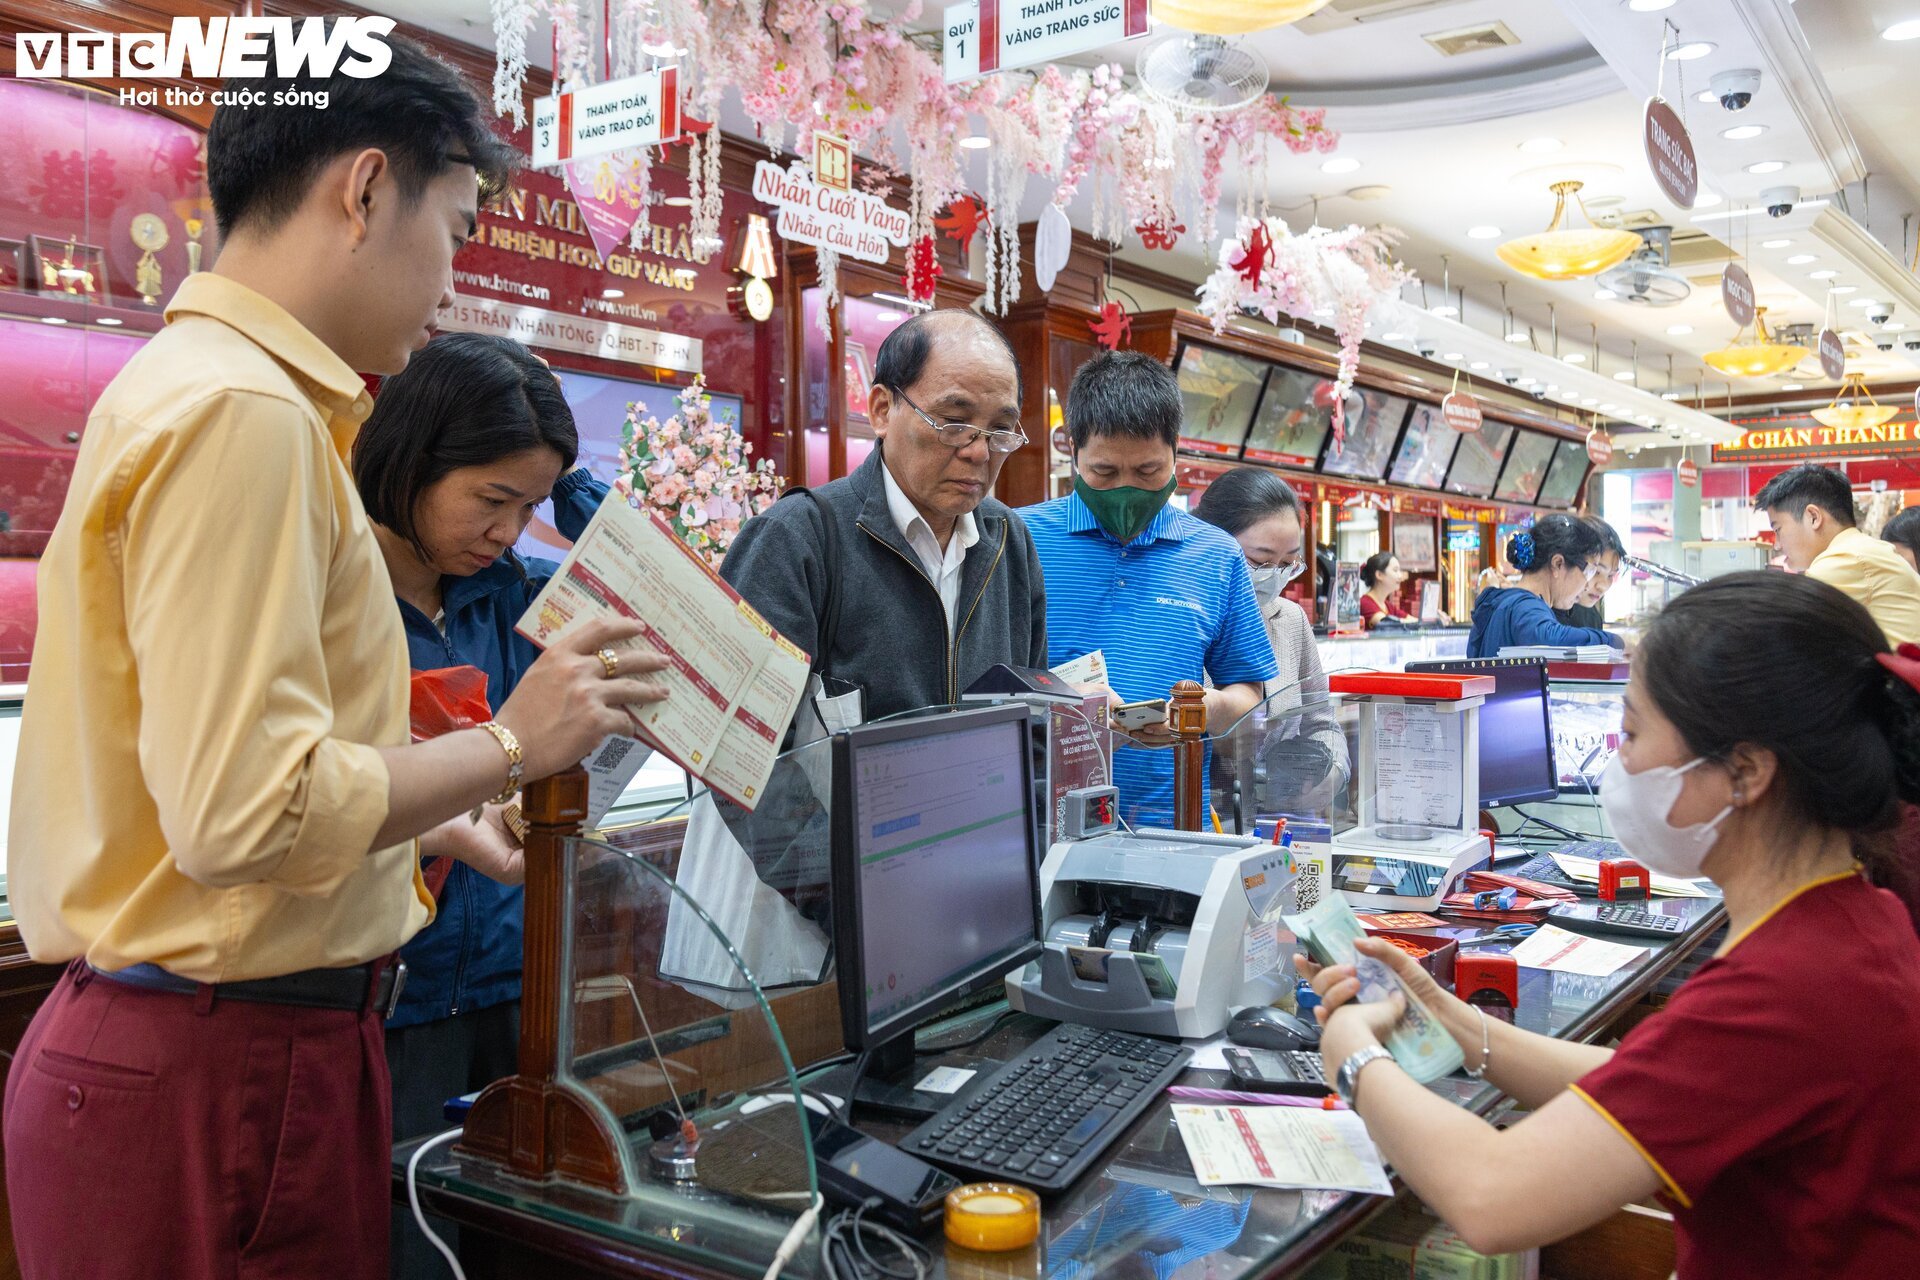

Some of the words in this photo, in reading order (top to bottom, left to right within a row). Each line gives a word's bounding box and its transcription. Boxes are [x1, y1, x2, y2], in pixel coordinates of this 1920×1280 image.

[1021, 0, 1063, 19] THANH
[949, 18, 975, 37] QUỸ
[1006, 27, 1042, 46] VÀNG
[1046, 15, 1089, 36] TRANG
[1093, 5, 1120, 24] SỨC
[957, 40, 964, 59] 1
[537, 112, 555, 128] QUỸ
[586, 101, 618, 118] THANH
[621, 95, 648, 110] TOÁN
[542, 131, 550, 148] 3
[579, 125, 606, 140] VÀNG
[609, 120, 633, 134] TRAO
[637, 109, 655, 127] ĐỔI
[1650, 116, 1671, 158] TRANG
[1671, 140, 1683, 172] SỨC
[1683, 154, 1694, 185] BẠC
[759, 169, 811, 206] Nhẫn
[817, 188, 857, 220] Cưới
[863, 200, 905, 239] Vàng
[783, 211, 822, 239] Nhẫn
[827, 223, 853, 247] Cầu
[856, 233, 884, 257] Hôn
[489, 225, 555, 260] NHIỆM
[606, 254, 642, 279] GIỮ
[644, 261, 695, 292] VÀNG
[452, 270, 550, 300] www.btmc.vn
[453, 306, 469, 322] 15
[472, 308, 511, 330] TRẦN
[515, 316, 555, 337] NHÂN
[559, 322, 594, 345] TÔNG
[605, 334, 642, 352] Q.HBT
[674, 348, 690, 361] HN
